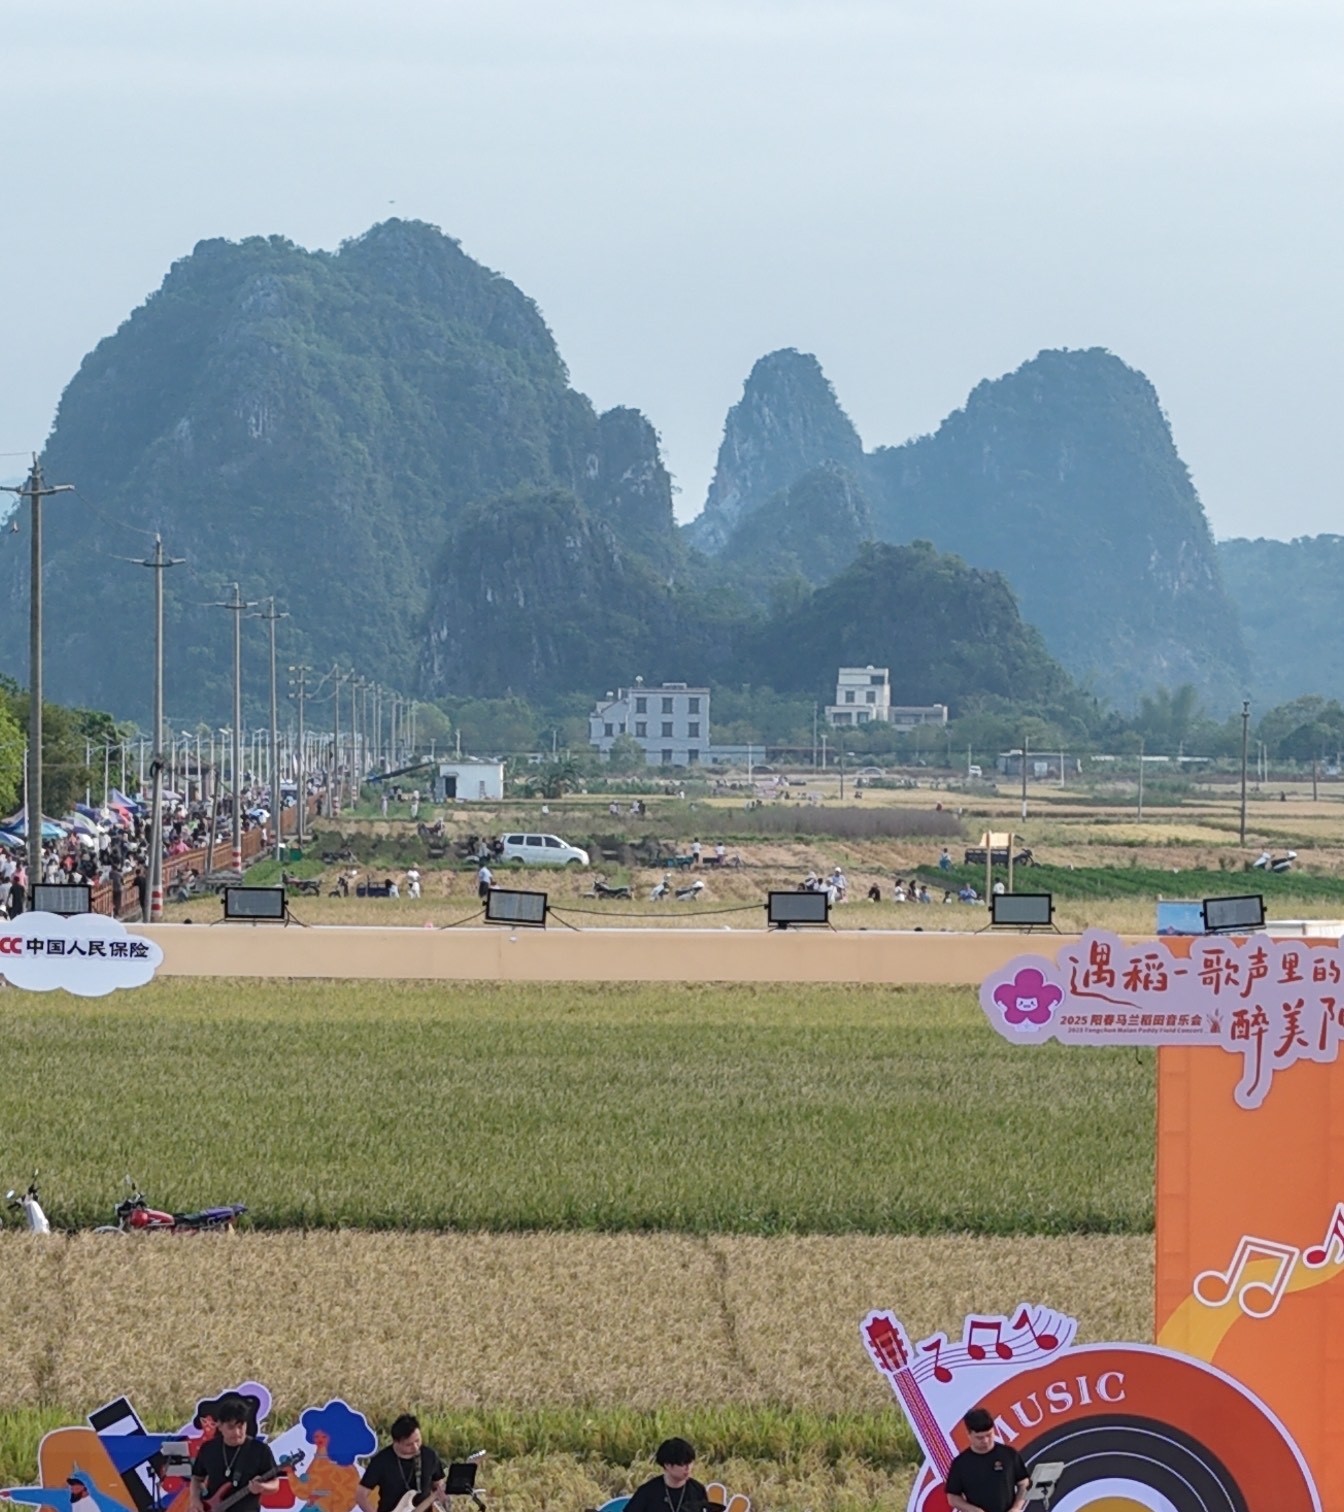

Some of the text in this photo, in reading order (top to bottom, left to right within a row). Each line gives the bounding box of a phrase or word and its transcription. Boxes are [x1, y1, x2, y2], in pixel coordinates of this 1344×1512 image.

[26, 937, 149, 959] 中国人民保险
[1059, 1014, 1203, 1027] 2025 阳春马兰稻田音乐会
